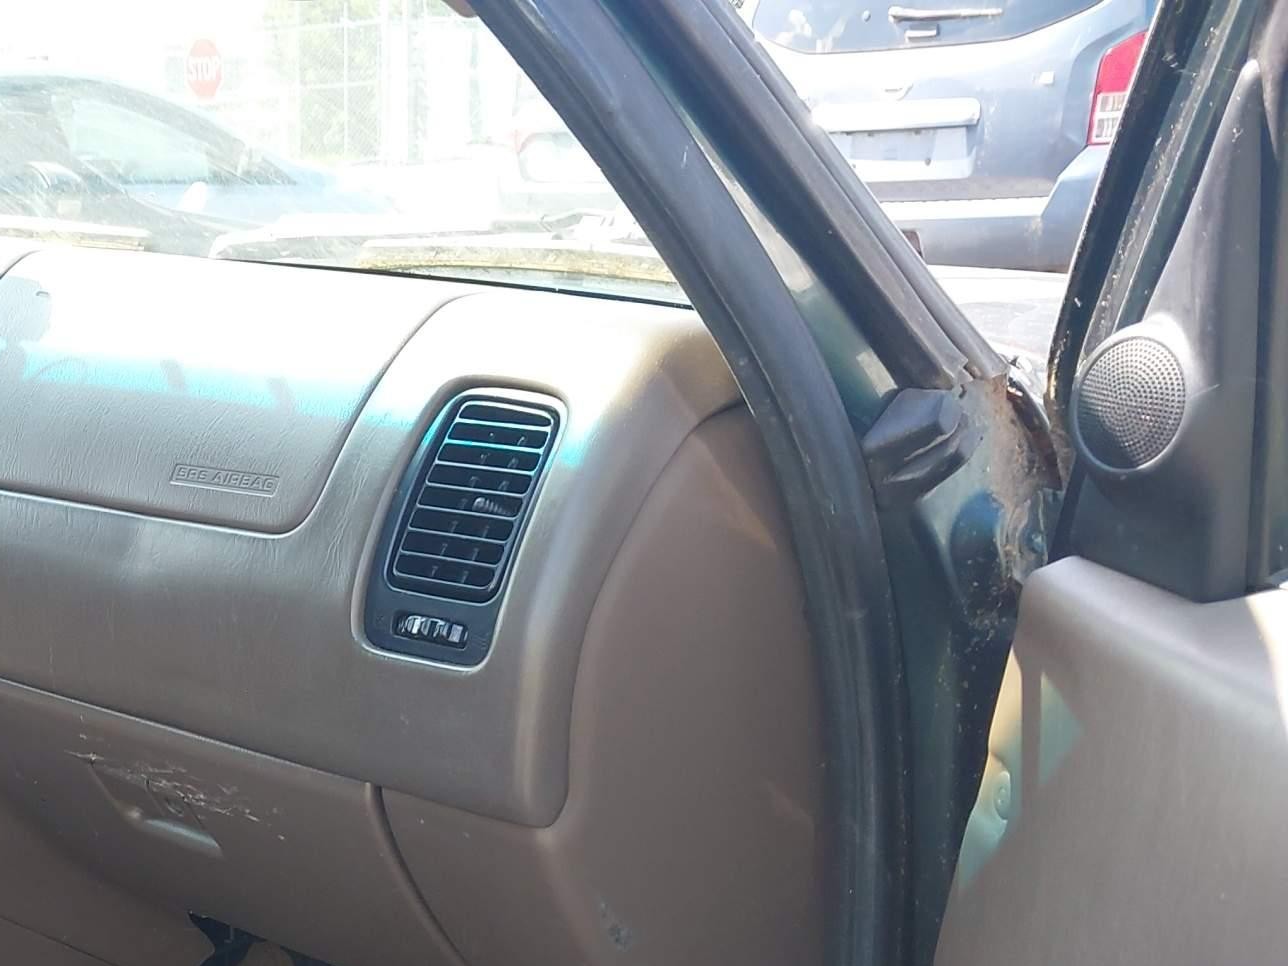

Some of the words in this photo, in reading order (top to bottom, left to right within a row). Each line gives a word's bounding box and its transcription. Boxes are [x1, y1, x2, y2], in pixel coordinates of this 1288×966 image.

[187, 56, 221, 81] STOP
[176, 467, 209, 481] SRS
[212, 471, 275, 491] AIRBAG
